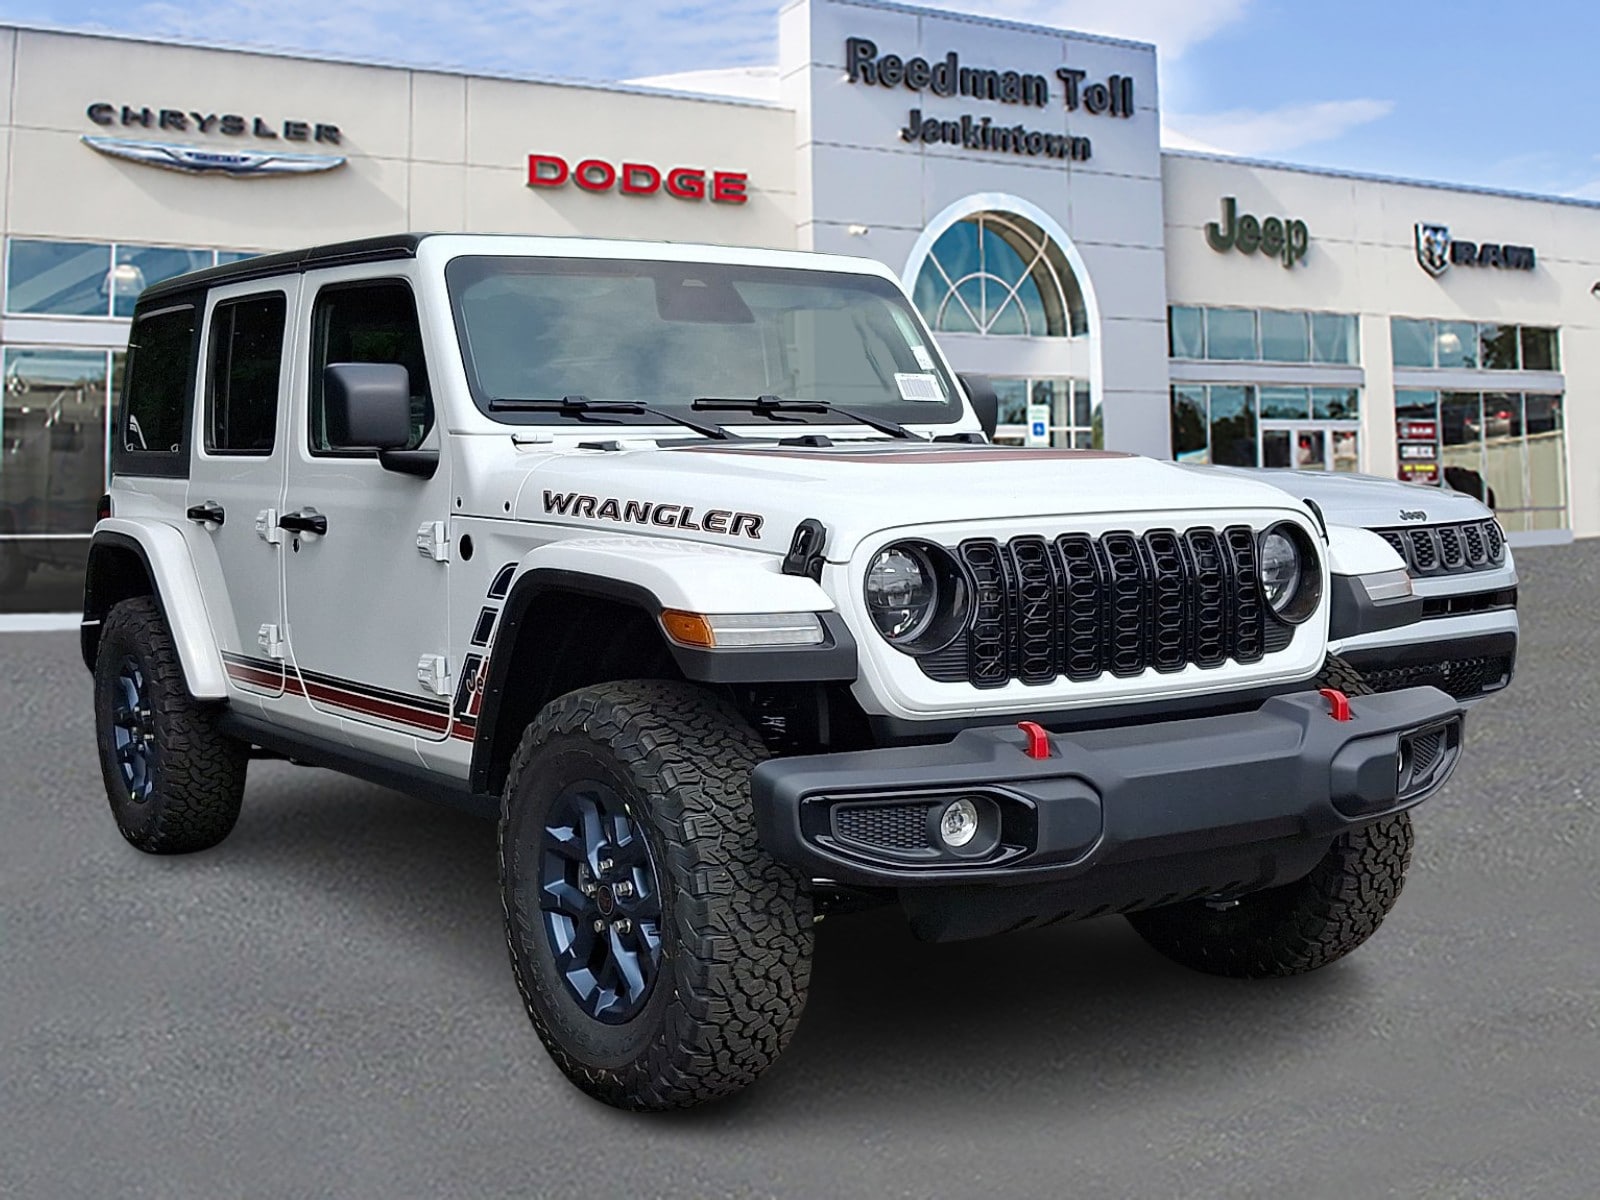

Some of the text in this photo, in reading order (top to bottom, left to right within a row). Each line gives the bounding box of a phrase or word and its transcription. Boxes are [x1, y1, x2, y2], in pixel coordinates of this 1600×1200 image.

[846, 37, 1134, 119] Reedman Toll
[87, 103, 341, 145] CHRYSLER
[901, 109, 1092, 161] Jenkintown
[527, 154, 748, 204] DODGE
[1204, 197, 1309, 270] Jeep
[1451, 240, 1536, 270] RAM
[542, 489, 765, 539] WRANGLER
[1399, 509, 1428, 522] Jeep
[466, 669, 485, 695] Je
